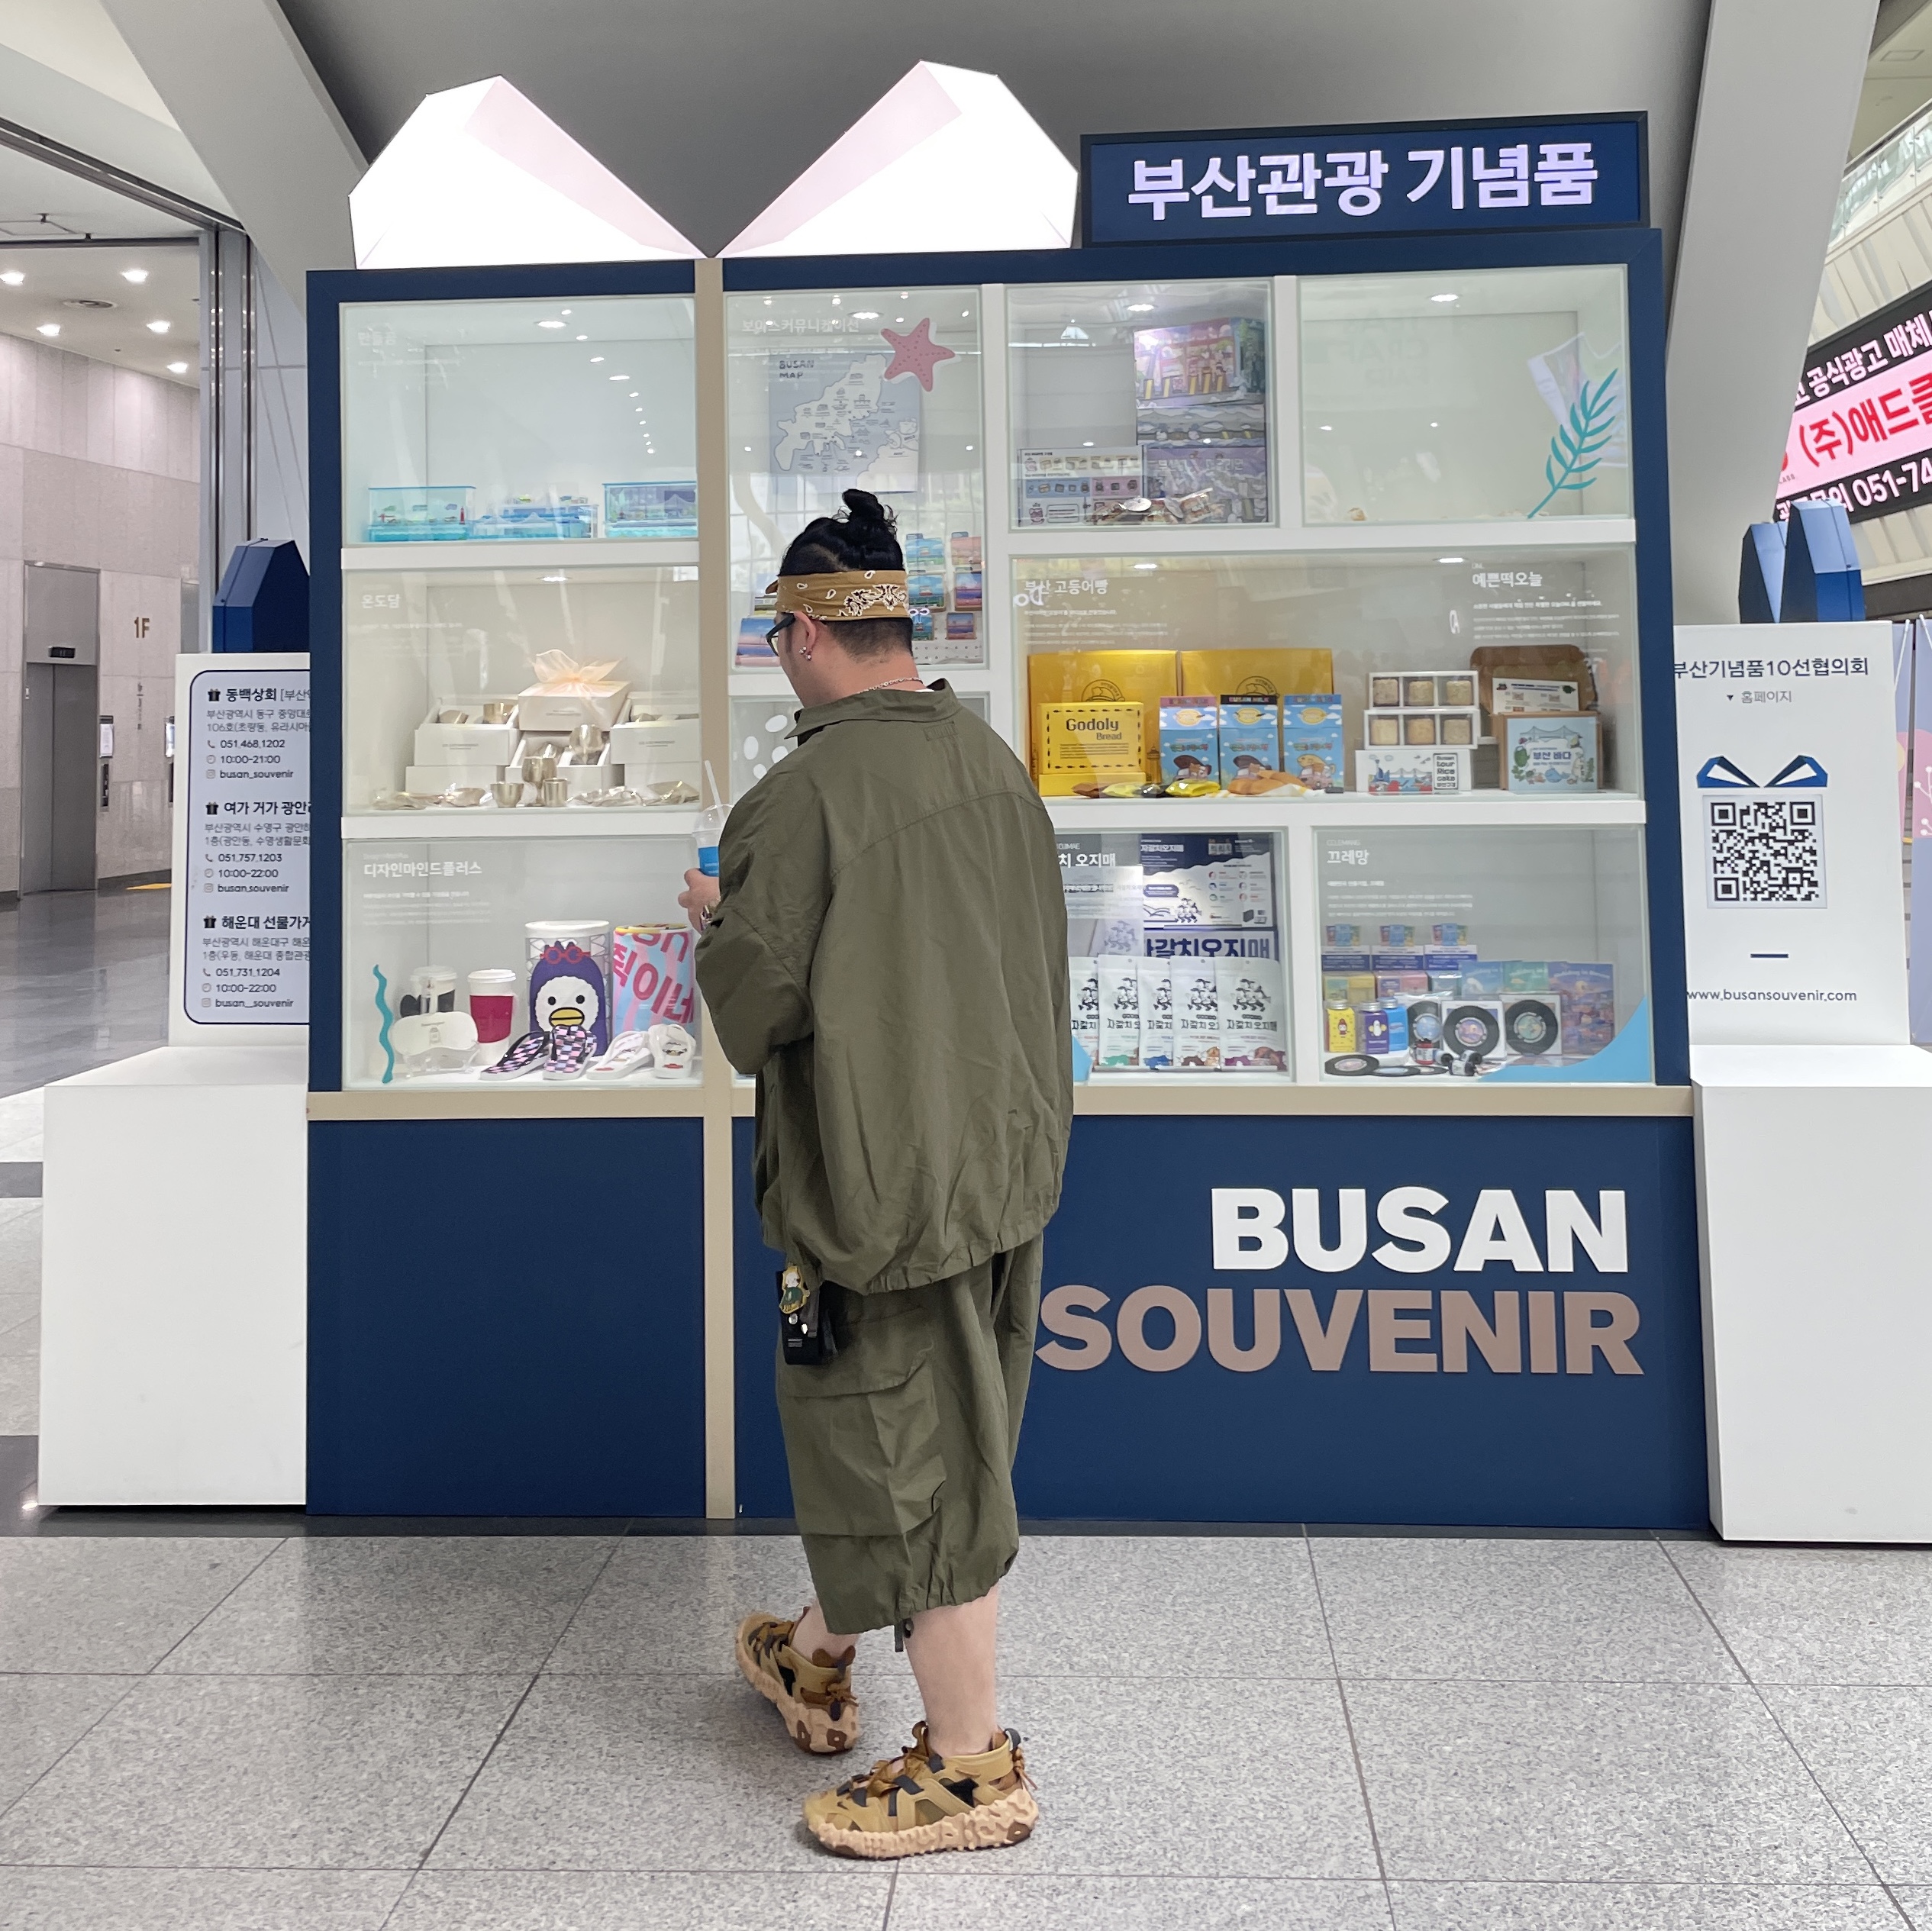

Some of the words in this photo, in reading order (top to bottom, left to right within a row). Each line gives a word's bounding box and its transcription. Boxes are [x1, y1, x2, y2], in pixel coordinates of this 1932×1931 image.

[1127, 149, 1389, 221] 부산관광
[1406, 142, 1599, 211] 기념품
[779, 359, 815, 369] BUSAN
[1806, 339, 1889, 398] 공식광고
[1024, 579, 1051, 595] 부산
[1054, 578, 1109, 595] 고등어빵
[1472, 571, 1543, 588] 예쁜떡오늘
[361, 594, 402, 609] 온도담
[134, 616, 150, 639] 1F
[1674, 656, 1869, 679] 부산기념품10선협의회
[225, 688, 277, 702] 동백상회
[279, 688, 311, 702] [부산
[1740, 689, 1792, 704] 홈페이지
[206, 708, 253, 720] 부산광역시
[256, 708, 275, 720] 동구
[1066, 717, 1119, 732] Godoly
[1095, 732, 1123, 741] Bread
[220, 739, 286, 750] 051.468.1202
[221, 755, 281, 765] 10:00-21:00
[219, 769, 295, 779] busan_souvenir
[224, 801, 250, 815] 여가
[253, 801, 279, 815] 거가
[204, 823, 251, 833] 부산광역시
[253, 822, 282, 833] 수영구
[218, 853, 283, 863] 051.757.1203
[1075, 853, 1117, 869] 오지매
[1327, 849, 1369, 866] 끄레망
[218, 868, 279, 878] 10:00-22:00
[363, 859, 483, 878] 디자인마인드플러스
[221, 915, 260, 930] 해운대
[202, 936, 250, 948] 부산광역시
[252, 936, 289, 948] 해운대구
[244, 949, 273, 962] 해운대
[215, 968, 281, 978] 051.731.1204
[216, 983, 277, 994] 10:00-22:00
[1687, 988, 1857, 1002] www.busansouvenir.com
[1211, 1185, 1629, 1273] BUSAN
[1034, 1284, 1645, 1375] SOUVENIR
